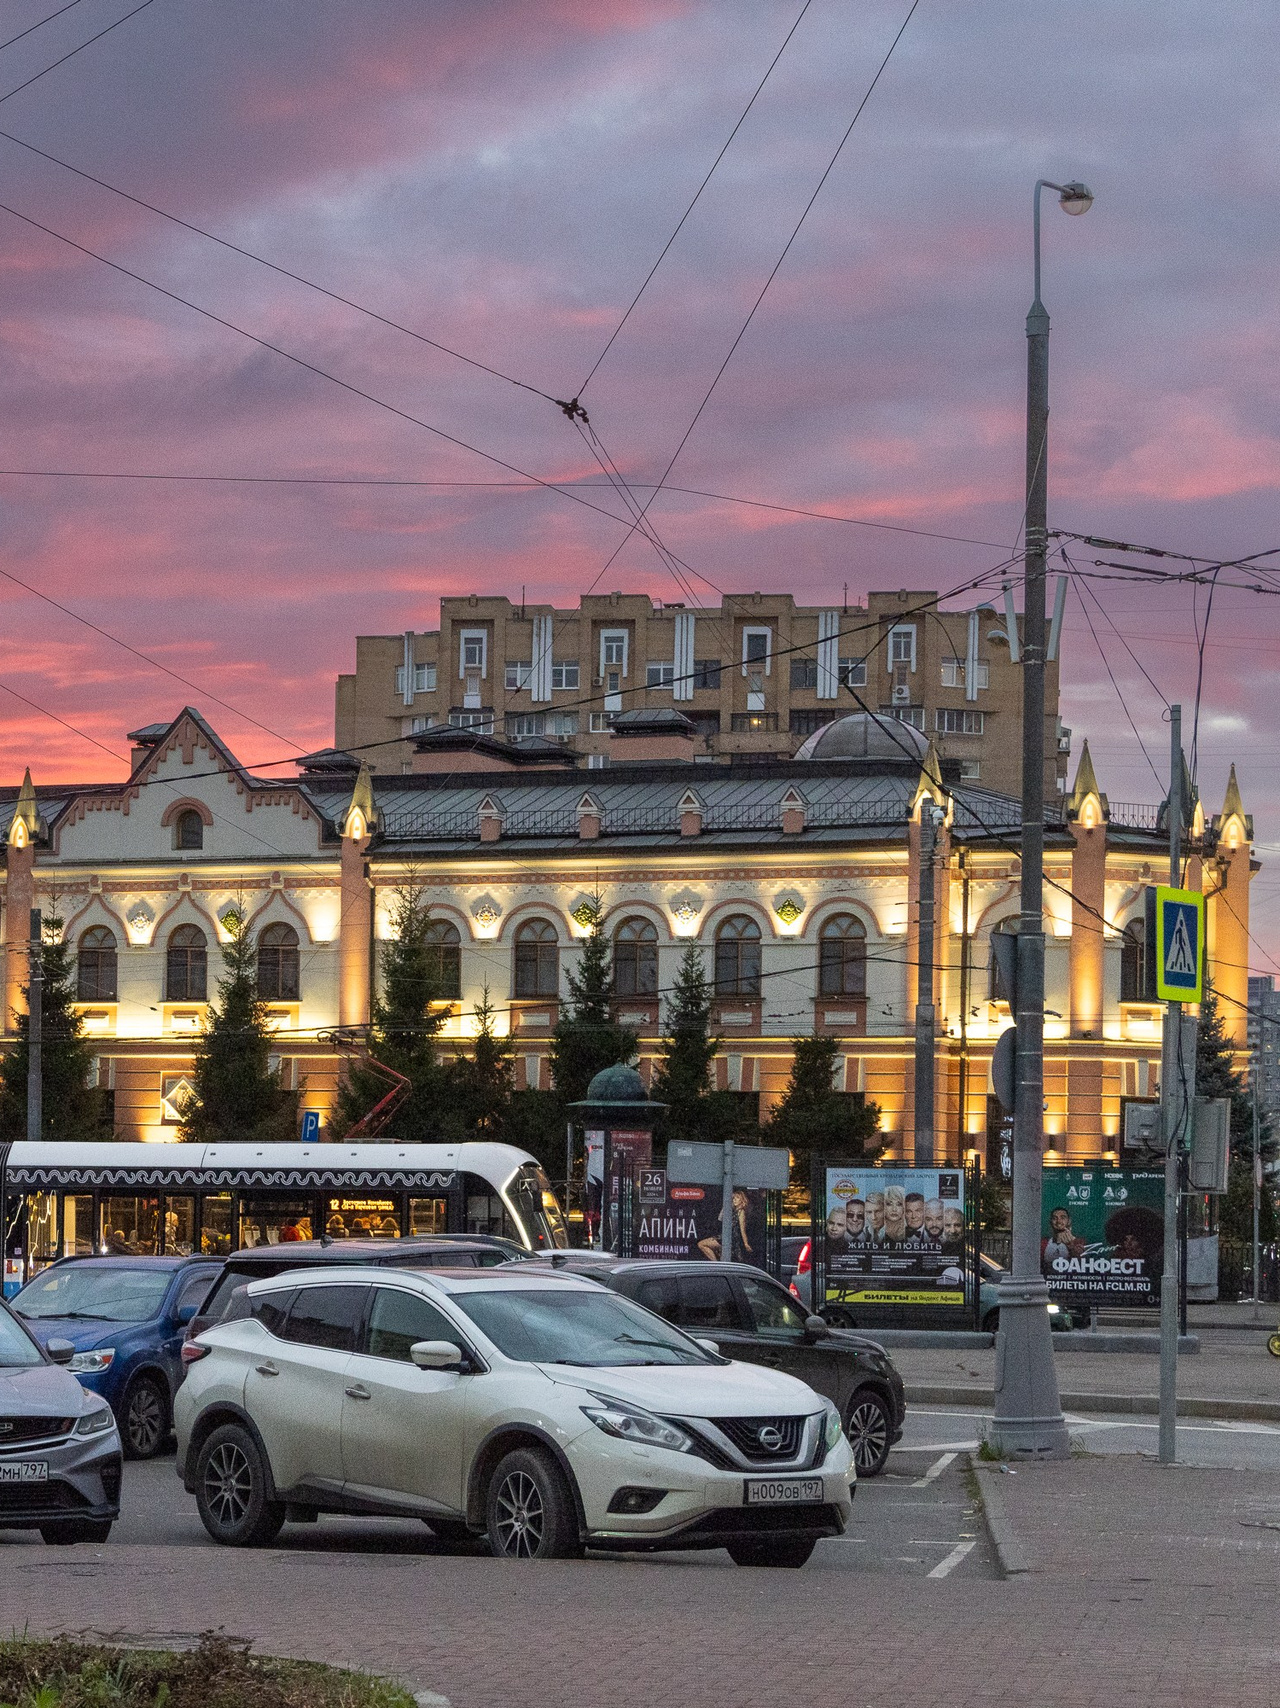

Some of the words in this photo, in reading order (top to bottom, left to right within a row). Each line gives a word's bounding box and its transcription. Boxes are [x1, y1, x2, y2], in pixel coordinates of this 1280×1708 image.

[644, 1173, 661, 1185] 26
[945, 1176, 952, 1186] 7
[329, 1199, 340, 1210] 12
[639, 1218, 698, 1239] АПИНА
[639, 1245, 689, 1254] КОМБИНАЦИЯ
[848, 1242, 879, 1250] ЖИТЬ
[883, 1242, 890, 1250] И
[895, 1242, 943, 1250] ЛЮБИТЬ
[1052, 1257, 1145, 1274] ФАНФЕСТ
[1046, 1281, 1087, 1290] БИЛЕТЫ
[1089, 1281, 1104, 1290] НА
[1106, 1282, 1151, 1291] FCLM.RU
[22, 1463, 44, 1475] 797
[752, 1482, 800, 1498] Н009ОВ
[801, 1482, 819, 1494] 197
